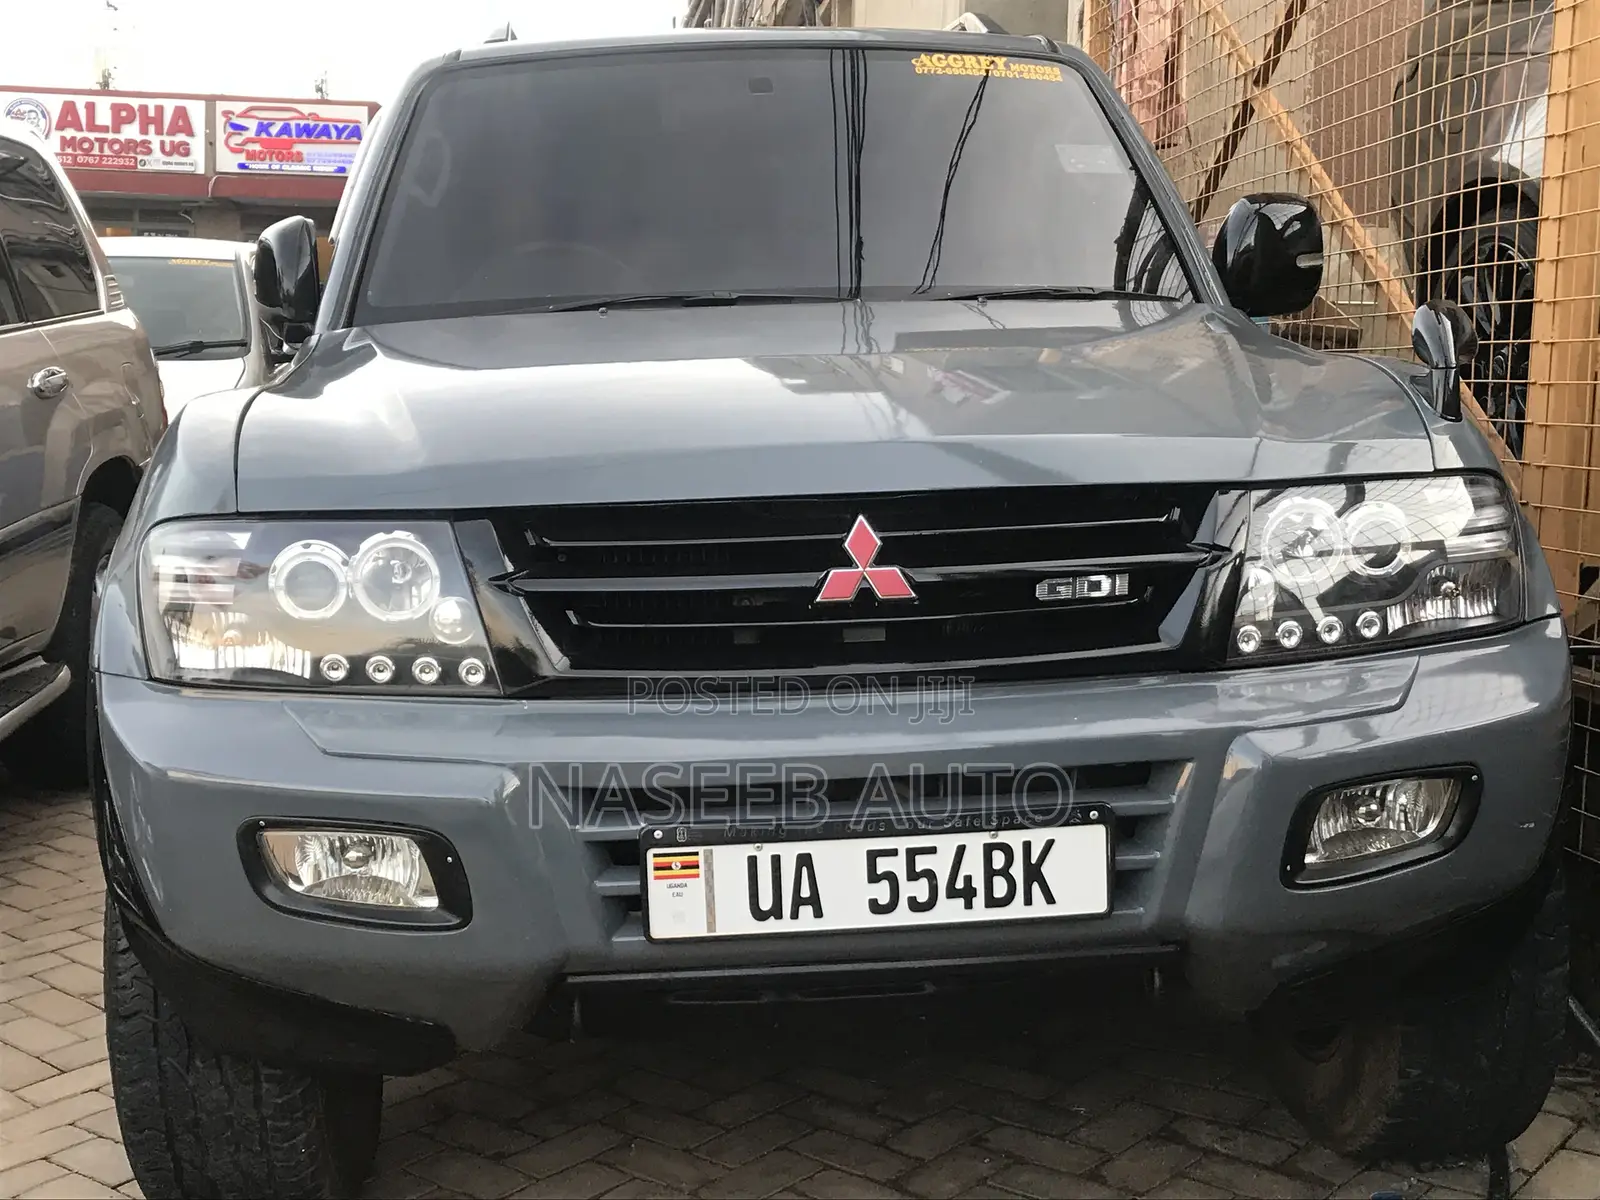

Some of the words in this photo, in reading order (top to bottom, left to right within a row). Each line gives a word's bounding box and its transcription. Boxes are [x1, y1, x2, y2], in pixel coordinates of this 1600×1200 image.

[911, 53, 1007, 70] AGGREY
[1009, 63, 1060, 75] MOTORS
[55, 100, 195, 137] ALPHA
[255, 121, 362, 140] KAWAYA
[60, 135, 153, 156] MOTORS
[160, 140, 190, 157] UG
[245, 149, 304, 163] MOTORS
[76, 156, 99, 165] 0767
[102, 157, 135, 166] 222932
[1035, 573, 1129, 601] GDI
[746, 851, 824, 922] UA
[865, 838, 1057, 916] 554BK
